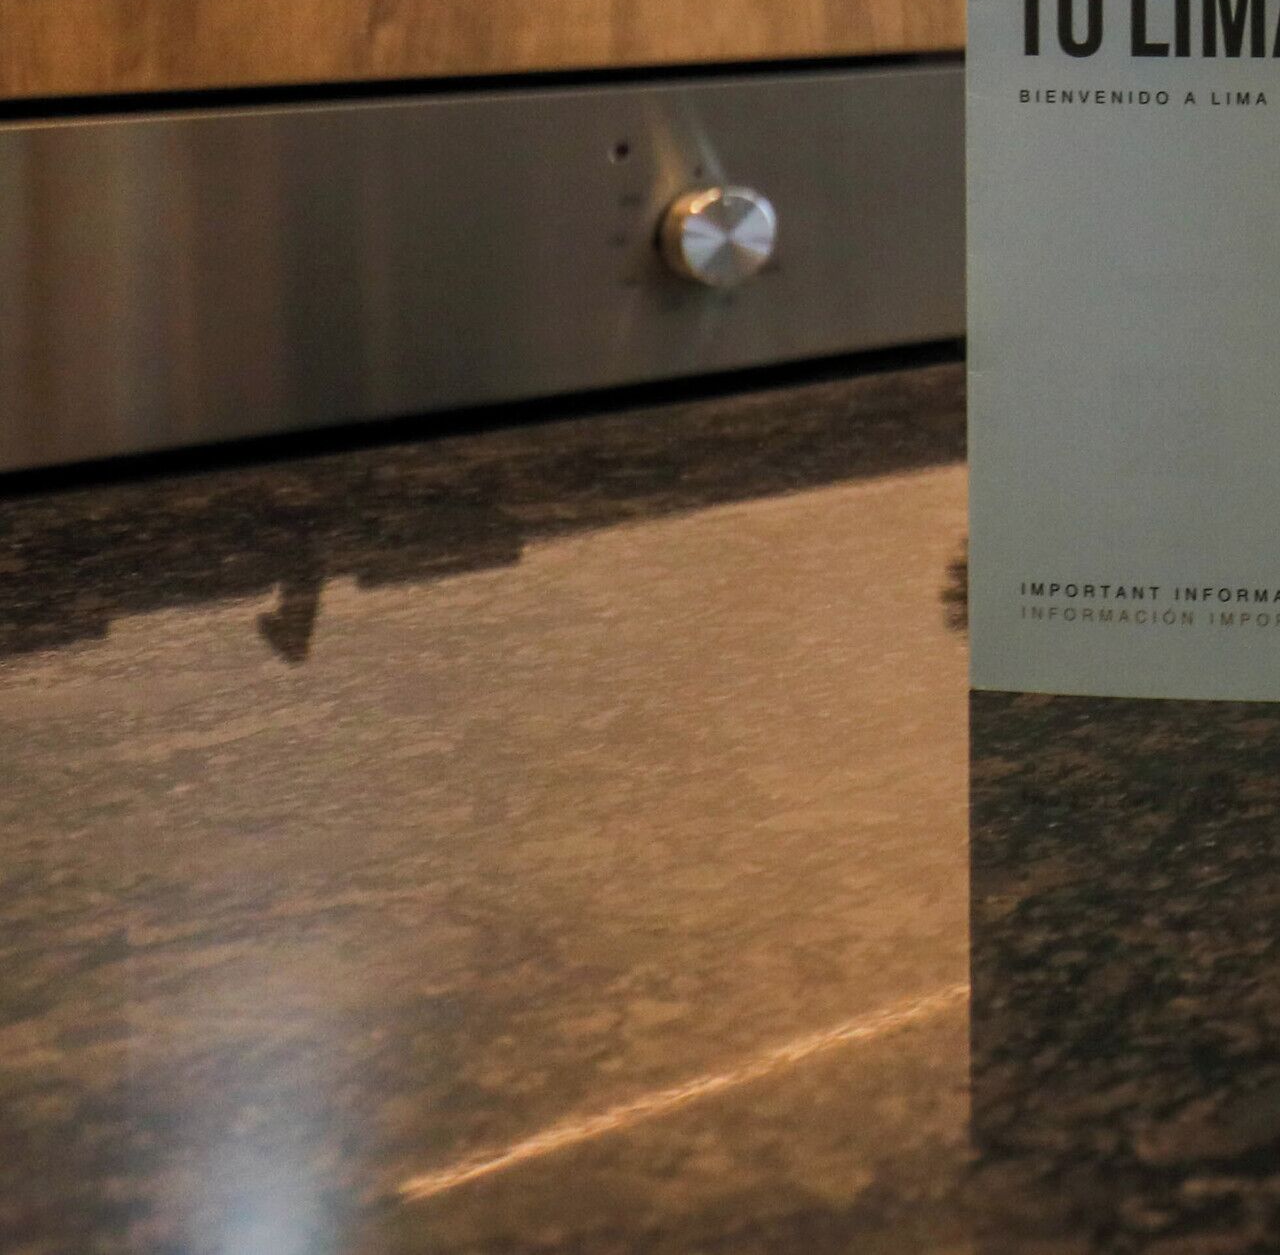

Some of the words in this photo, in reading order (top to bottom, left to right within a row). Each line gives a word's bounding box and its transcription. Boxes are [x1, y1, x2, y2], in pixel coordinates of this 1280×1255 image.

[1018, 89, 1170, 105] BIENVENIDO
[1184, 90, 1196, 105] A
[1210, 90, 1268, 106] LIMA
[1021, 582, 1161, 601] IMPORTANT
